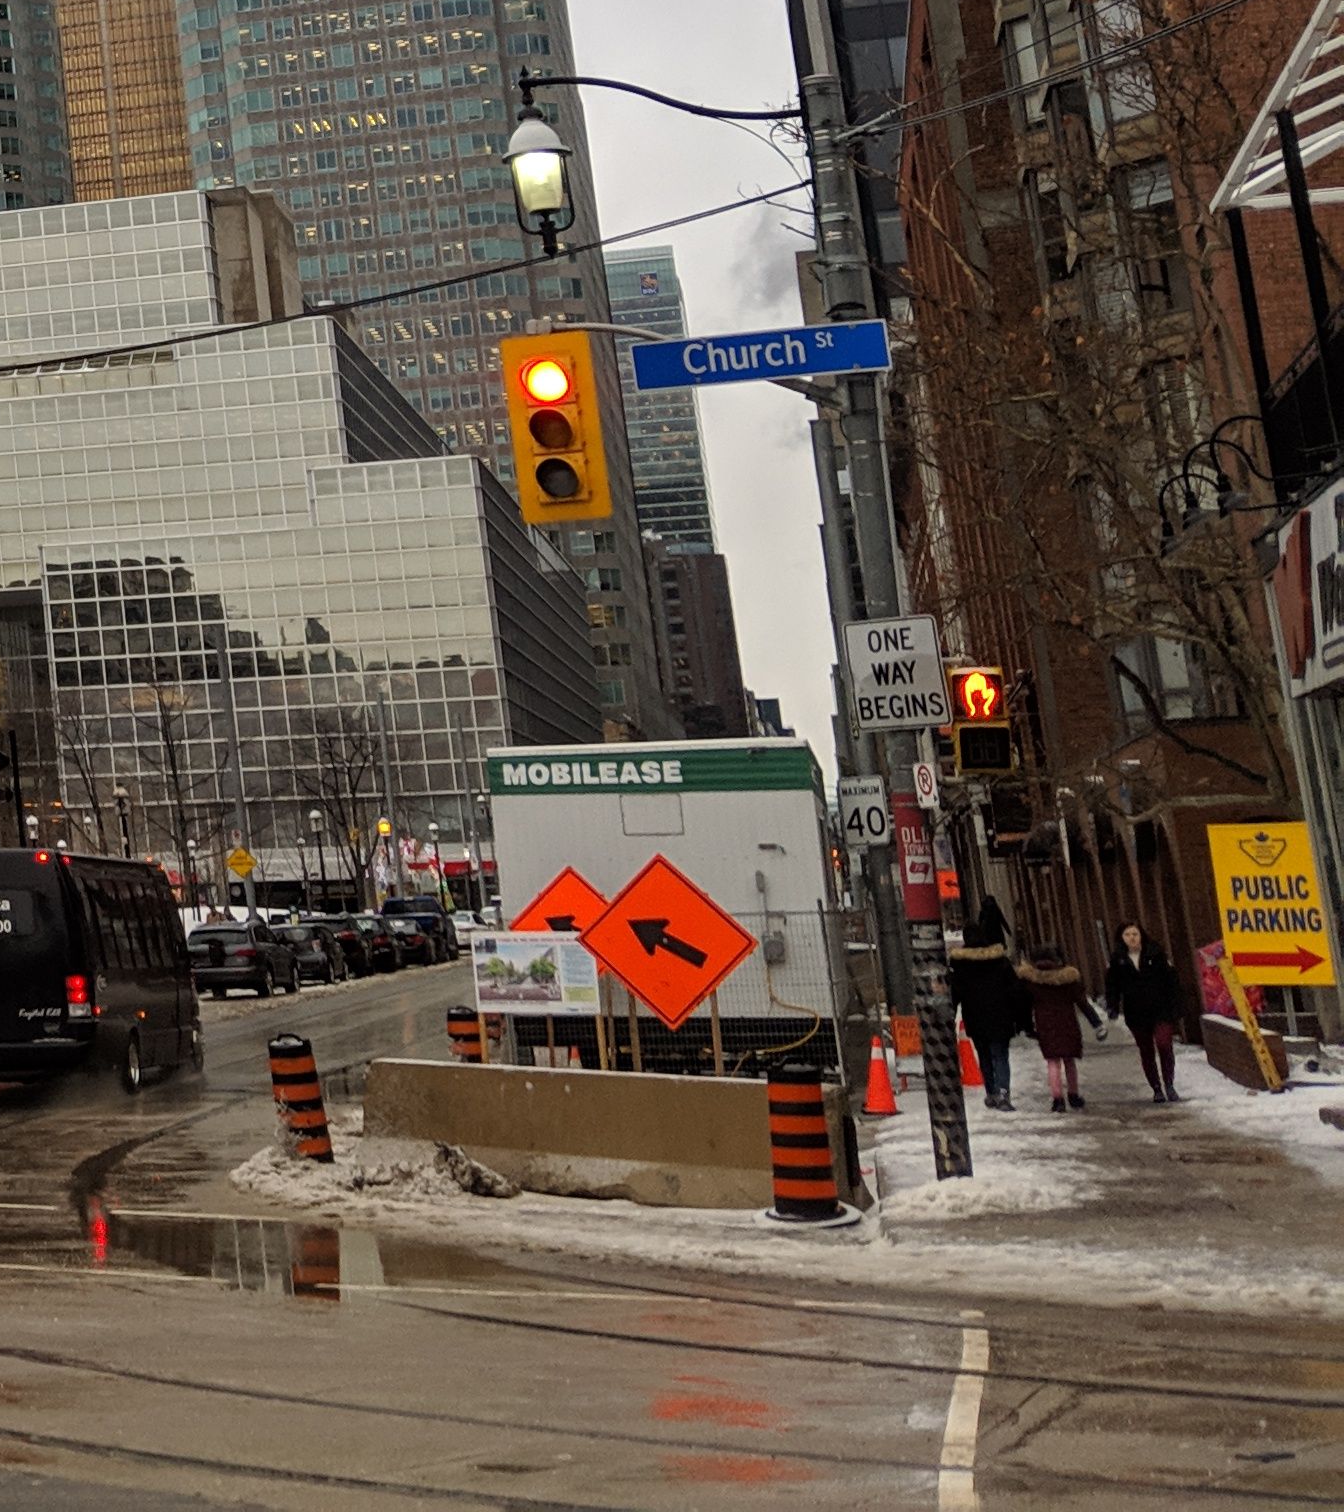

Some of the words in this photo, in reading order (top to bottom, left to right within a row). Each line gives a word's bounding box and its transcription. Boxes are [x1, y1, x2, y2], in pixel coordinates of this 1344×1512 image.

[683, 334, 807, 375] Church
[815, 331, 834, 349] St
[868, 627, 914, 653] ONE
[871, 660, 916, 686] WAY
[859, 692, 944, 721] BEGINS
[502, 760, 683, 786] MOBILEASE
[841, 785, 880, 796] MAXIMUM
[847, 806, 886, 838] 40
[1231, 875, 1310, 900] PUBLIC
[1227, 907, 1322, 933] PARKING
